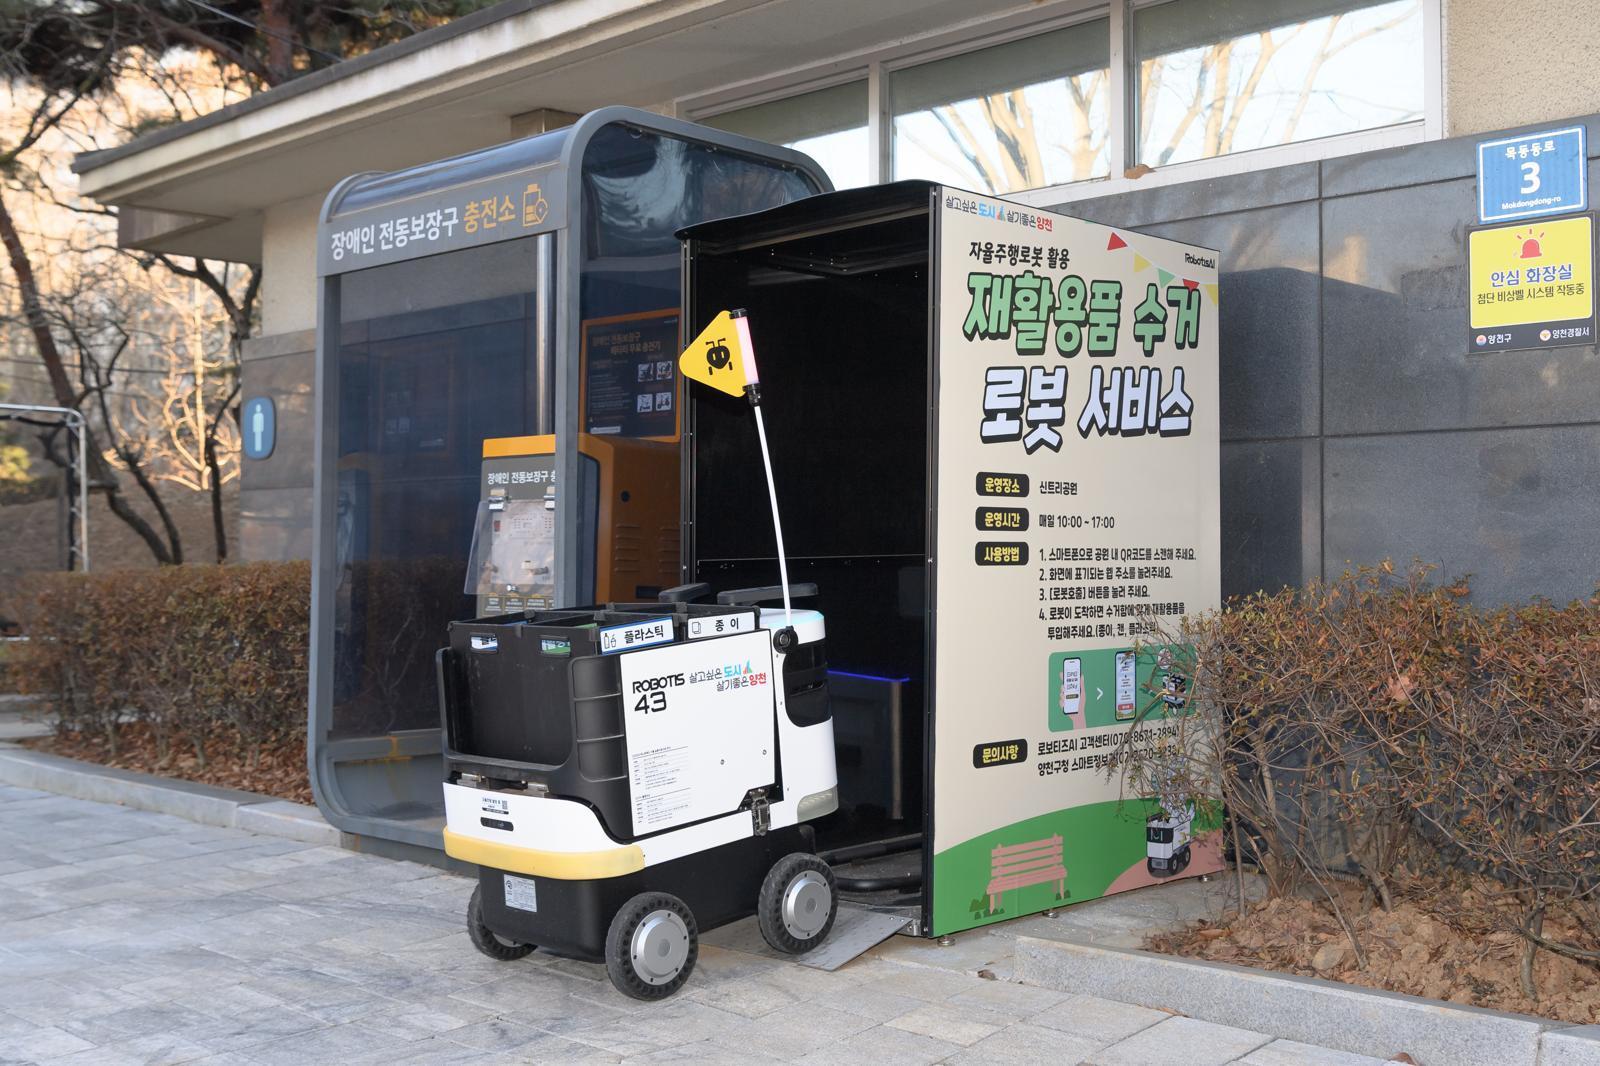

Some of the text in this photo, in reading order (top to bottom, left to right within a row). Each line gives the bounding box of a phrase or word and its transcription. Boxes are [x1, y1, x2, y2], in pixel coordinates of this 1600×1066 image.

[1505, 140, 1556, 161] 목동동로
[1520, 161, 1541, 195] 3
[1502, 196, 1561, 210] Mokdongdong-ro
[331, 195, 516, 261] 장애인 전동보장구 충전소
[969, 241, 1070, 270] 자율주행로봇 활용
[1491, 264, 1573, 287] 안심 화장실
[1477, 282, 1585, 305] 첨단 비상벨 시스템 작동중
[962, 270, 1201, 358] 재활용품 수거
[1552, 327, 1590, 340] 양천경찰서
[980, 365, 1194, 455] 로봇 서비스
[487, 472, 510, 485] 장애인
[511, 470, 549, 484] 전동보장구
[985, 477, 1078, 496] 운영장소 신트리공원
[984, 512, 1021, 528] 운영시간
[1039, 514, 1055, 528] 매일
[1057, 515, 1083, 529] 10:00
[1091, 516, 1115, 529] 17:00
[984, 547, 1197, 563] 사용방법 1. 스마트폰으로 공원 내 QR코드를 스캔해 주세요.
[1039, 568, 1047, 581] 2.
[1049, 567, 1073, 581] 화면에
[1075, 567, 1104, 580] 표기되는
[1115, 567, 1136, 580] 주소를
[1039, 585, 1150, 601] 3. [로봇호출] 버튼을 눌러 주세요.
[1039, 608, 1047, 621] 4.
[1049, 606, 1072, 620] 로봇이
[1074, 605, 1104, 619] 도착하면
[1106, 604, 1135, 618] 수거함에
[624, 625, 664, 644] 플라스틱
[632, 673, 685, 694] ROBOTIS
[689, 663, 742, 684] 살고싶은 도시
[634, 691, 667, 714] 43
[982, 744, 1019, 764] 문의사항
[1038, 741, 1078, 757] 로보티즈AI
[1038, 761, 1069, 777] 양천구청
